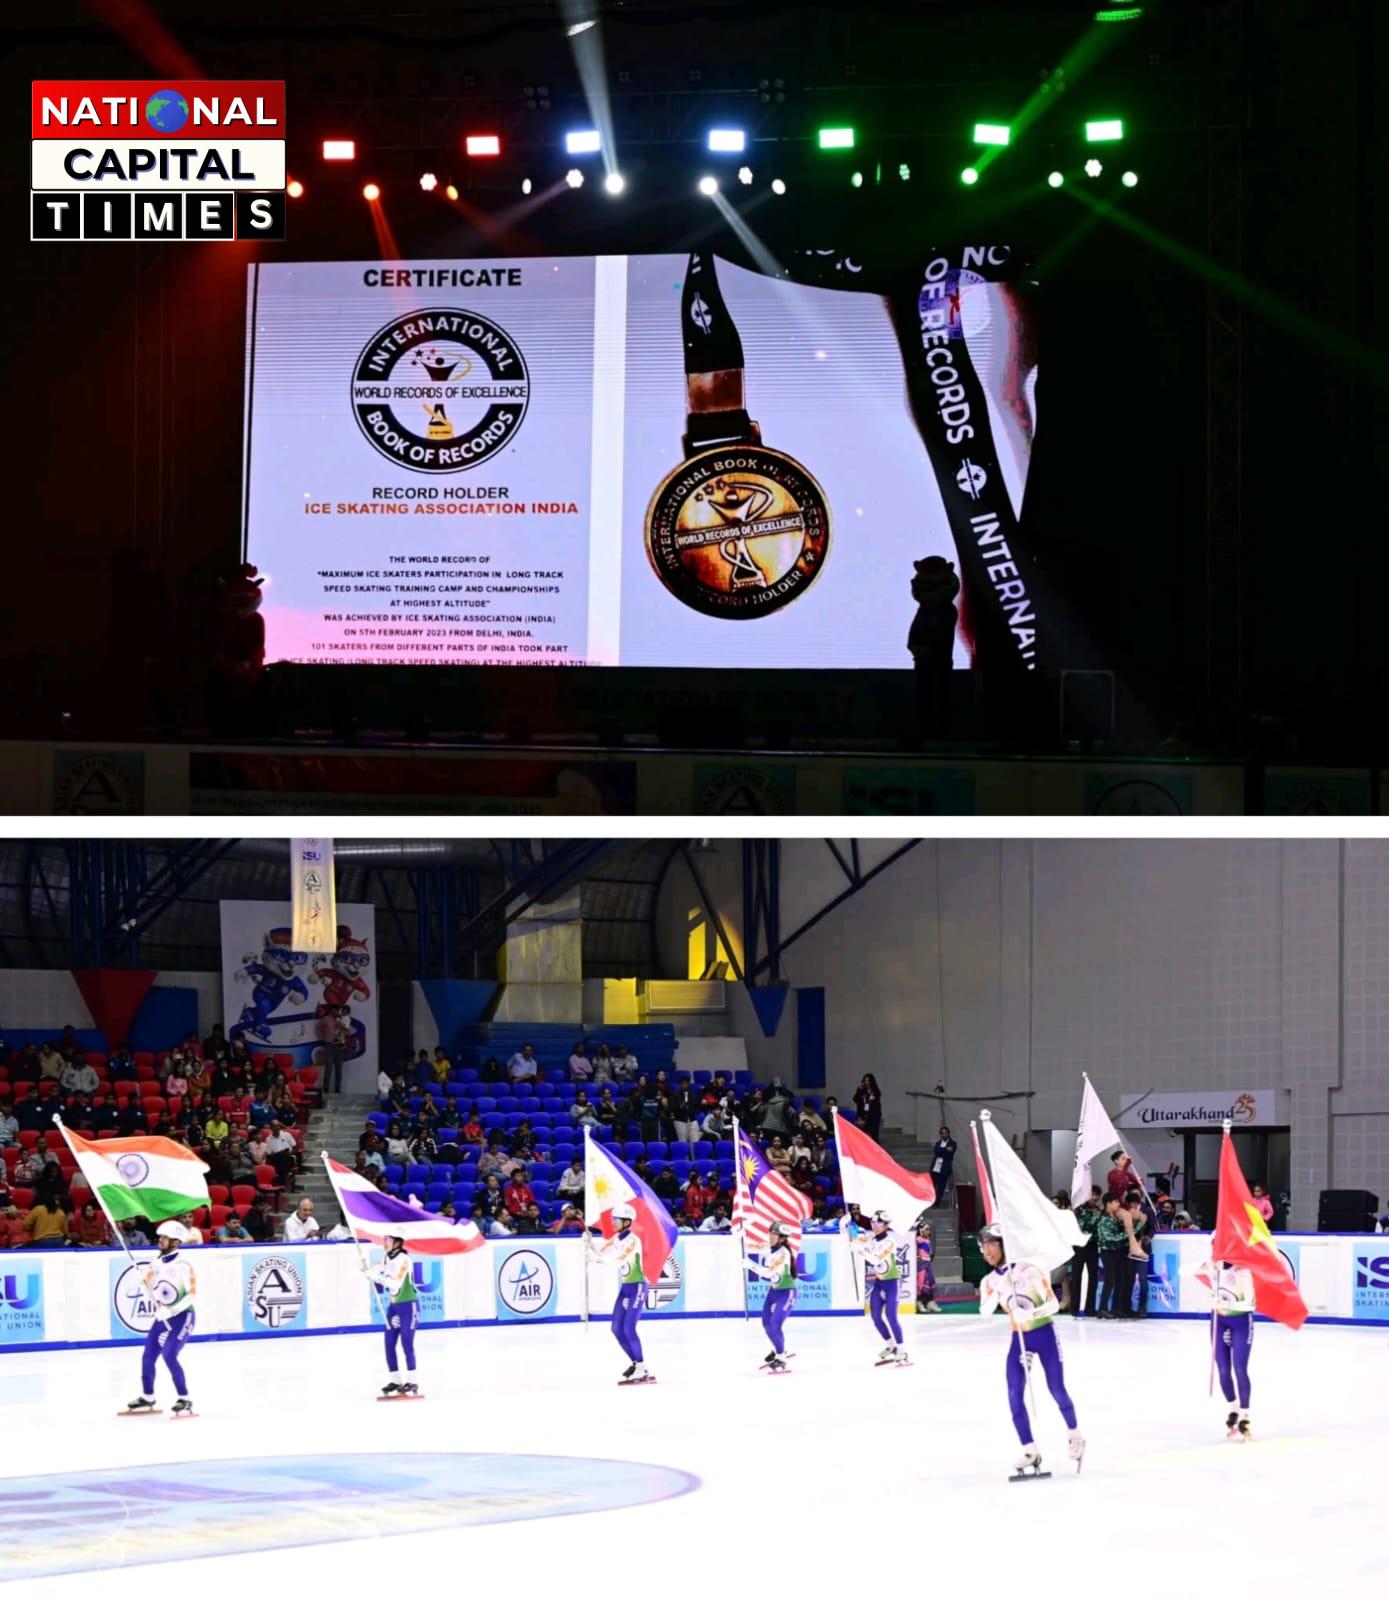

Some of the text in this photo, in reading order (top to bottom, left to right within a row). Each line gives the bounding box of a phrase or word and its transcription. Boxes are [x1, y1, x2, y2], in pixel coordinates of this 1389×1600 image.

[363, 268, 522, 288] CERTIFICATE
[368, 316, 513, 373] INTERNATIONAL
[921, 308, 974, 445] RECORDS
[354, 386, 527, 399] WORLD RECORDS OF EXCELLENCE
[366, 410, 514, 465] BOOK OF RECORDS
[372, 486, 509, 500] RECORD HOLDER
[304, 502, 579, 515] ICE SKATING ASSOCIATION INDIA
[660, 468, 712, 570] INTERNATIONAL
[713, 458, 758, 472] BOOK
[678, 516, 802, 546] WORLD RECORDS OF EXCELLENCE
[323, 585, 351, 593] SPEED
[353, 585, 392, 593] SKATING
[394, 585, 436, 593] TRAINING
[438, 585, 462, 593] CAMP
[752, 569, 803, 606] HOLDER
[969, 512, 1036, 671] INTERNA
[463, 615, 522, 623] ASSOCIATION
[524, 616, 556, 624] (INDIA)
[426, 629, 446, 637] 2023
[448, 629, 473, 637] FROM
[475, 630, 505, 638] DELHI,
[369, 643, 394, 651] FROM
[1137, 1105, 1235, 1123] Uttarakhand
[255, 1259, 288, 1275] SKATING
[287, 1265, 302, 1294] UNION
[519, 1284, 541, 1297] AIR
[7, 1321, 41, 1330] UNION
